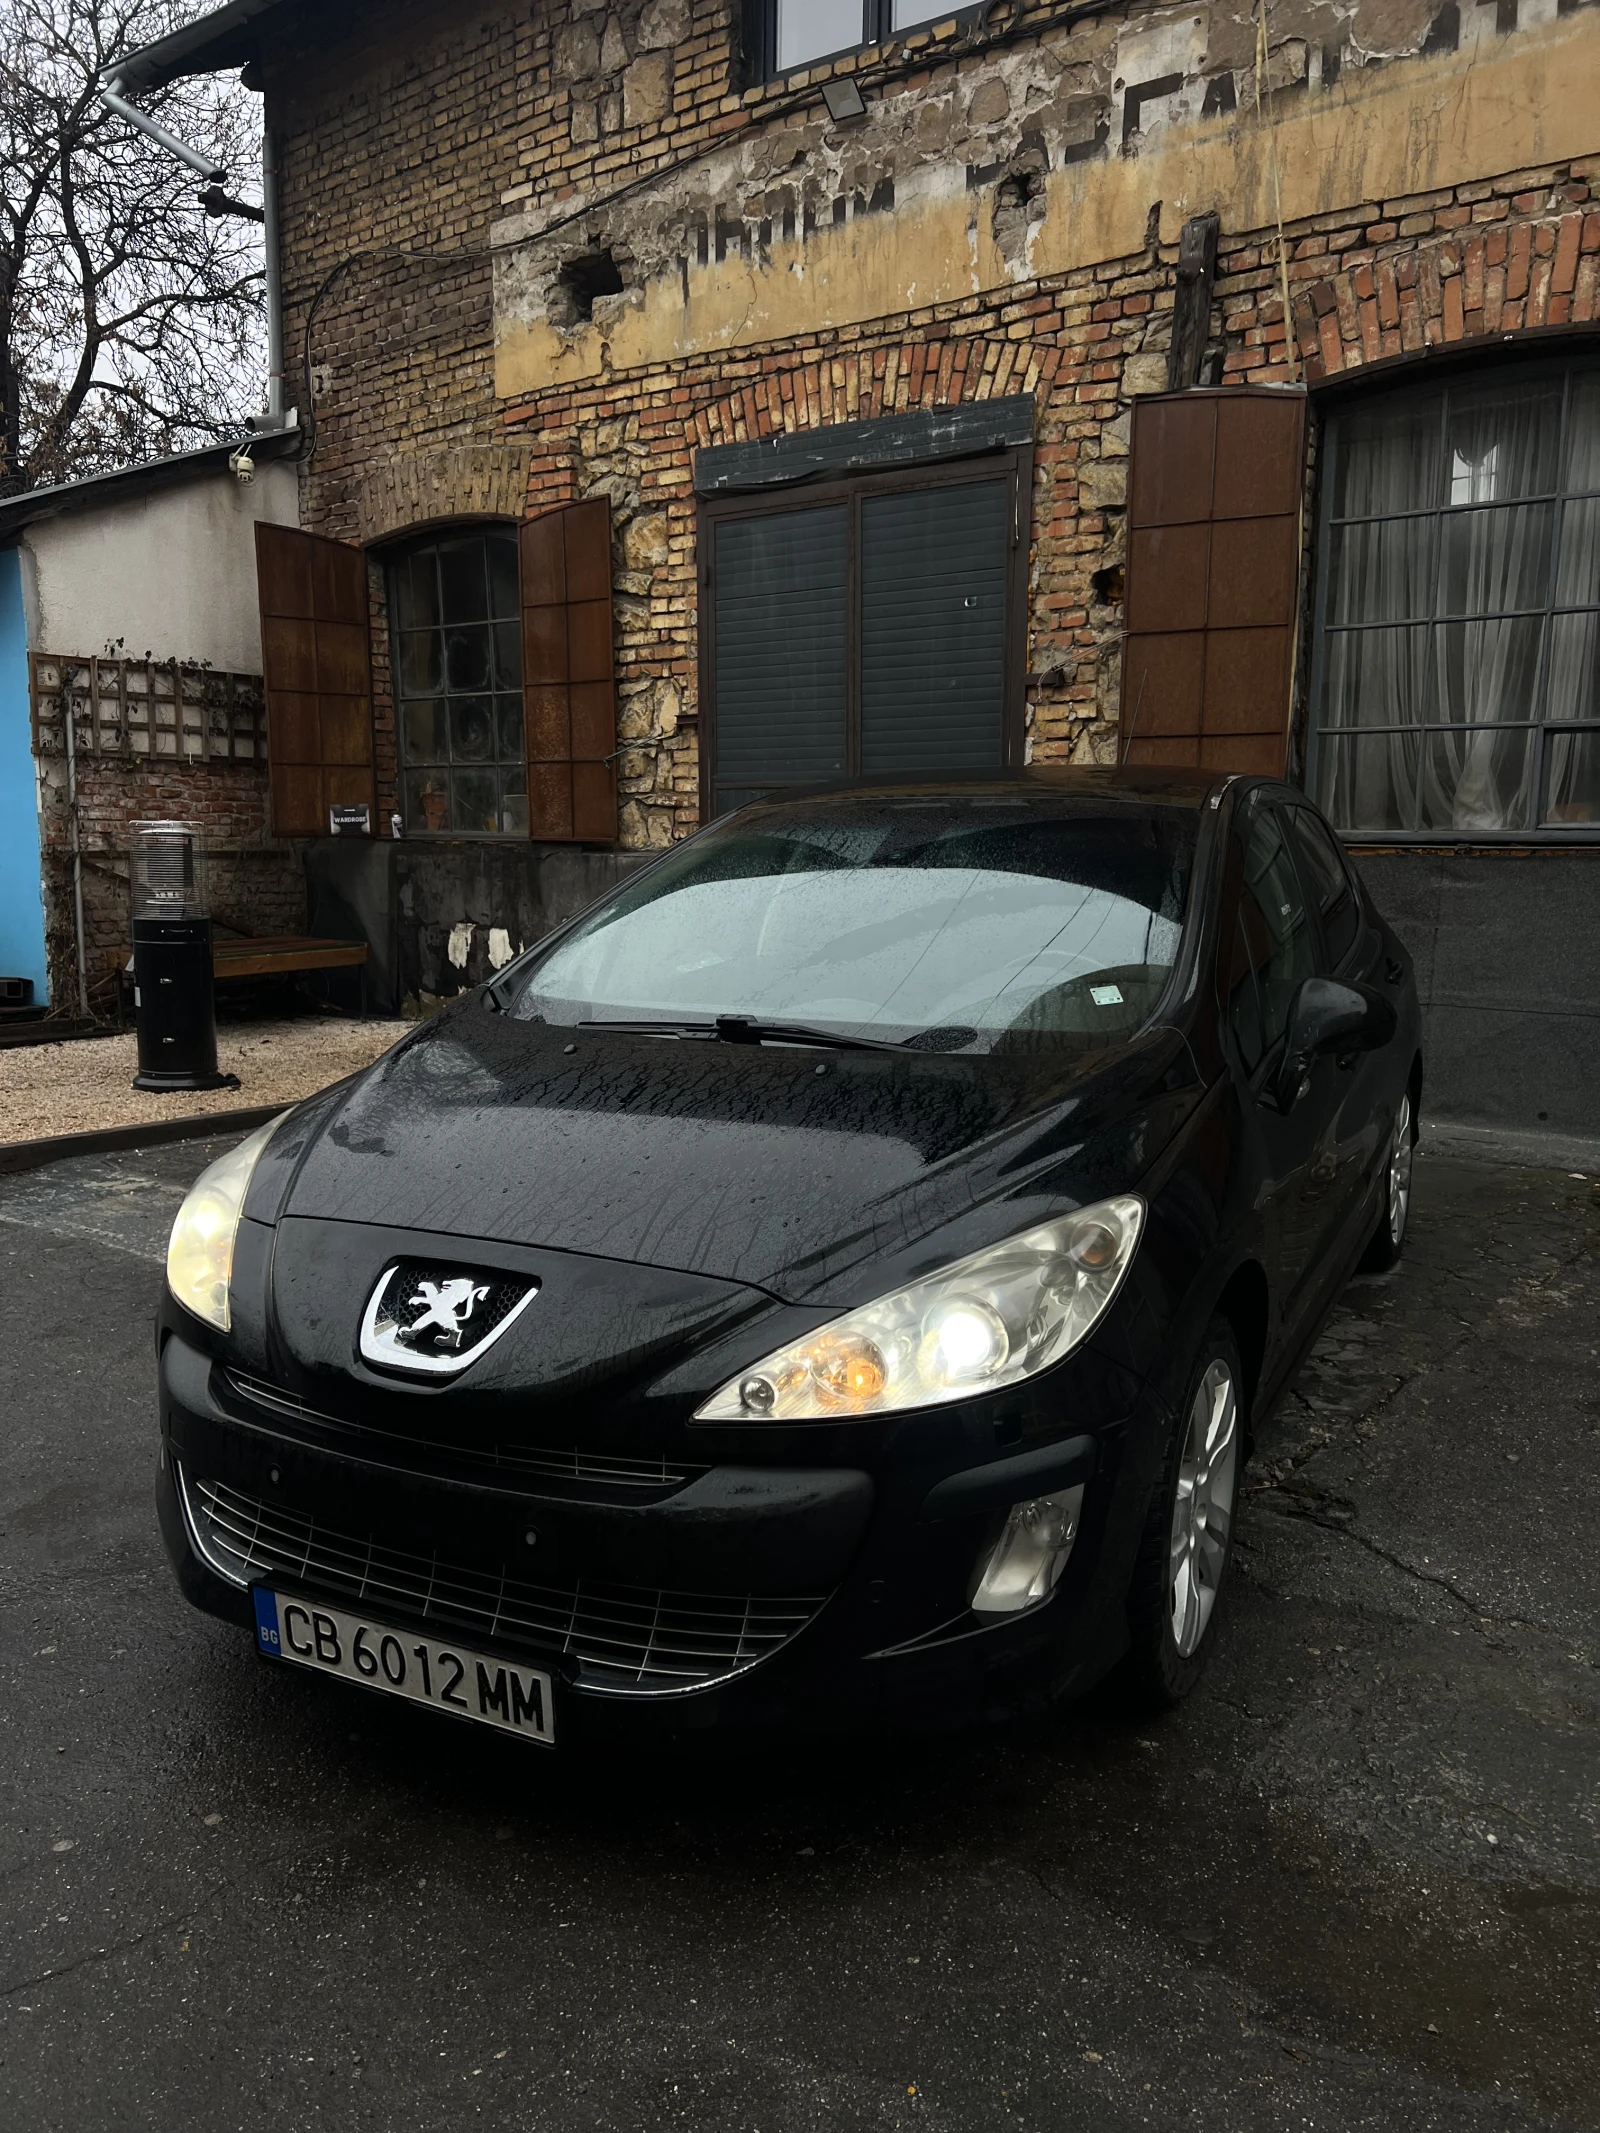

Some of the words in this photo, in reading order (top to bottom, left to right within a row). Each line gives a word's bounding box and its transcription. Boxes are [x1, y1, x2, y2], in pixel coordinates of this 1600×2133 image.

[260, 1626, 279, 1645] BG
[284, 1603, 342, 1666] CB
[353, 1625, 468, 1709] 6012
[475, 1659, 545, 1733] MM
